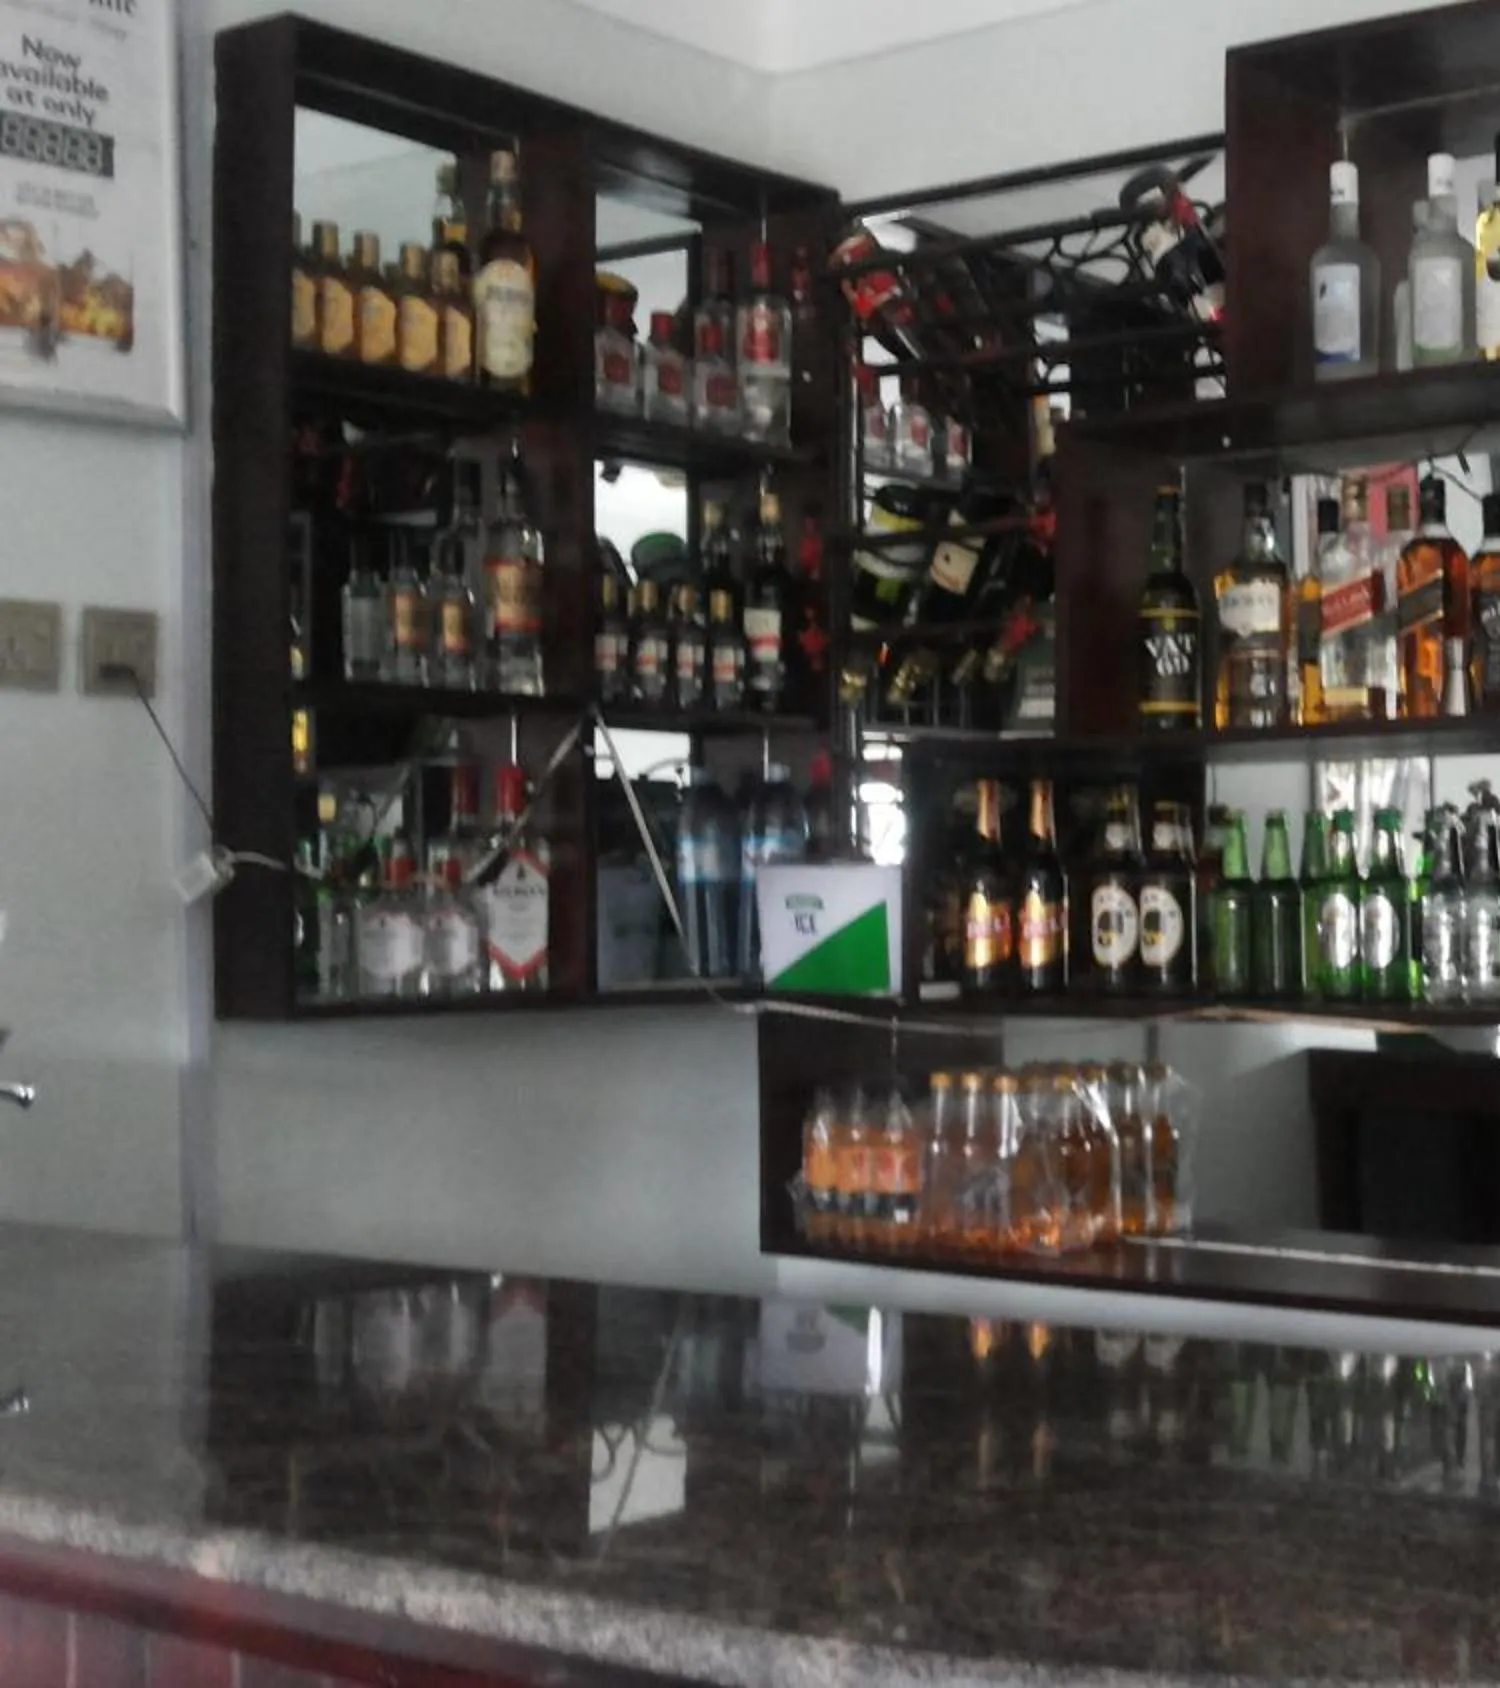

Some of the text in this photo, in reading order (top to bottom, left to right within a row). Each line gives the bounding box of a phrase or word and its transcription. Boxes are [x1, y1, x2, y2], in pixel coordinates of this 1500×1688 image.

[22, 33, 82, 70] Now
[6, 85, 96, 129] at only
[1144, 632, 1197, 660] VAT
